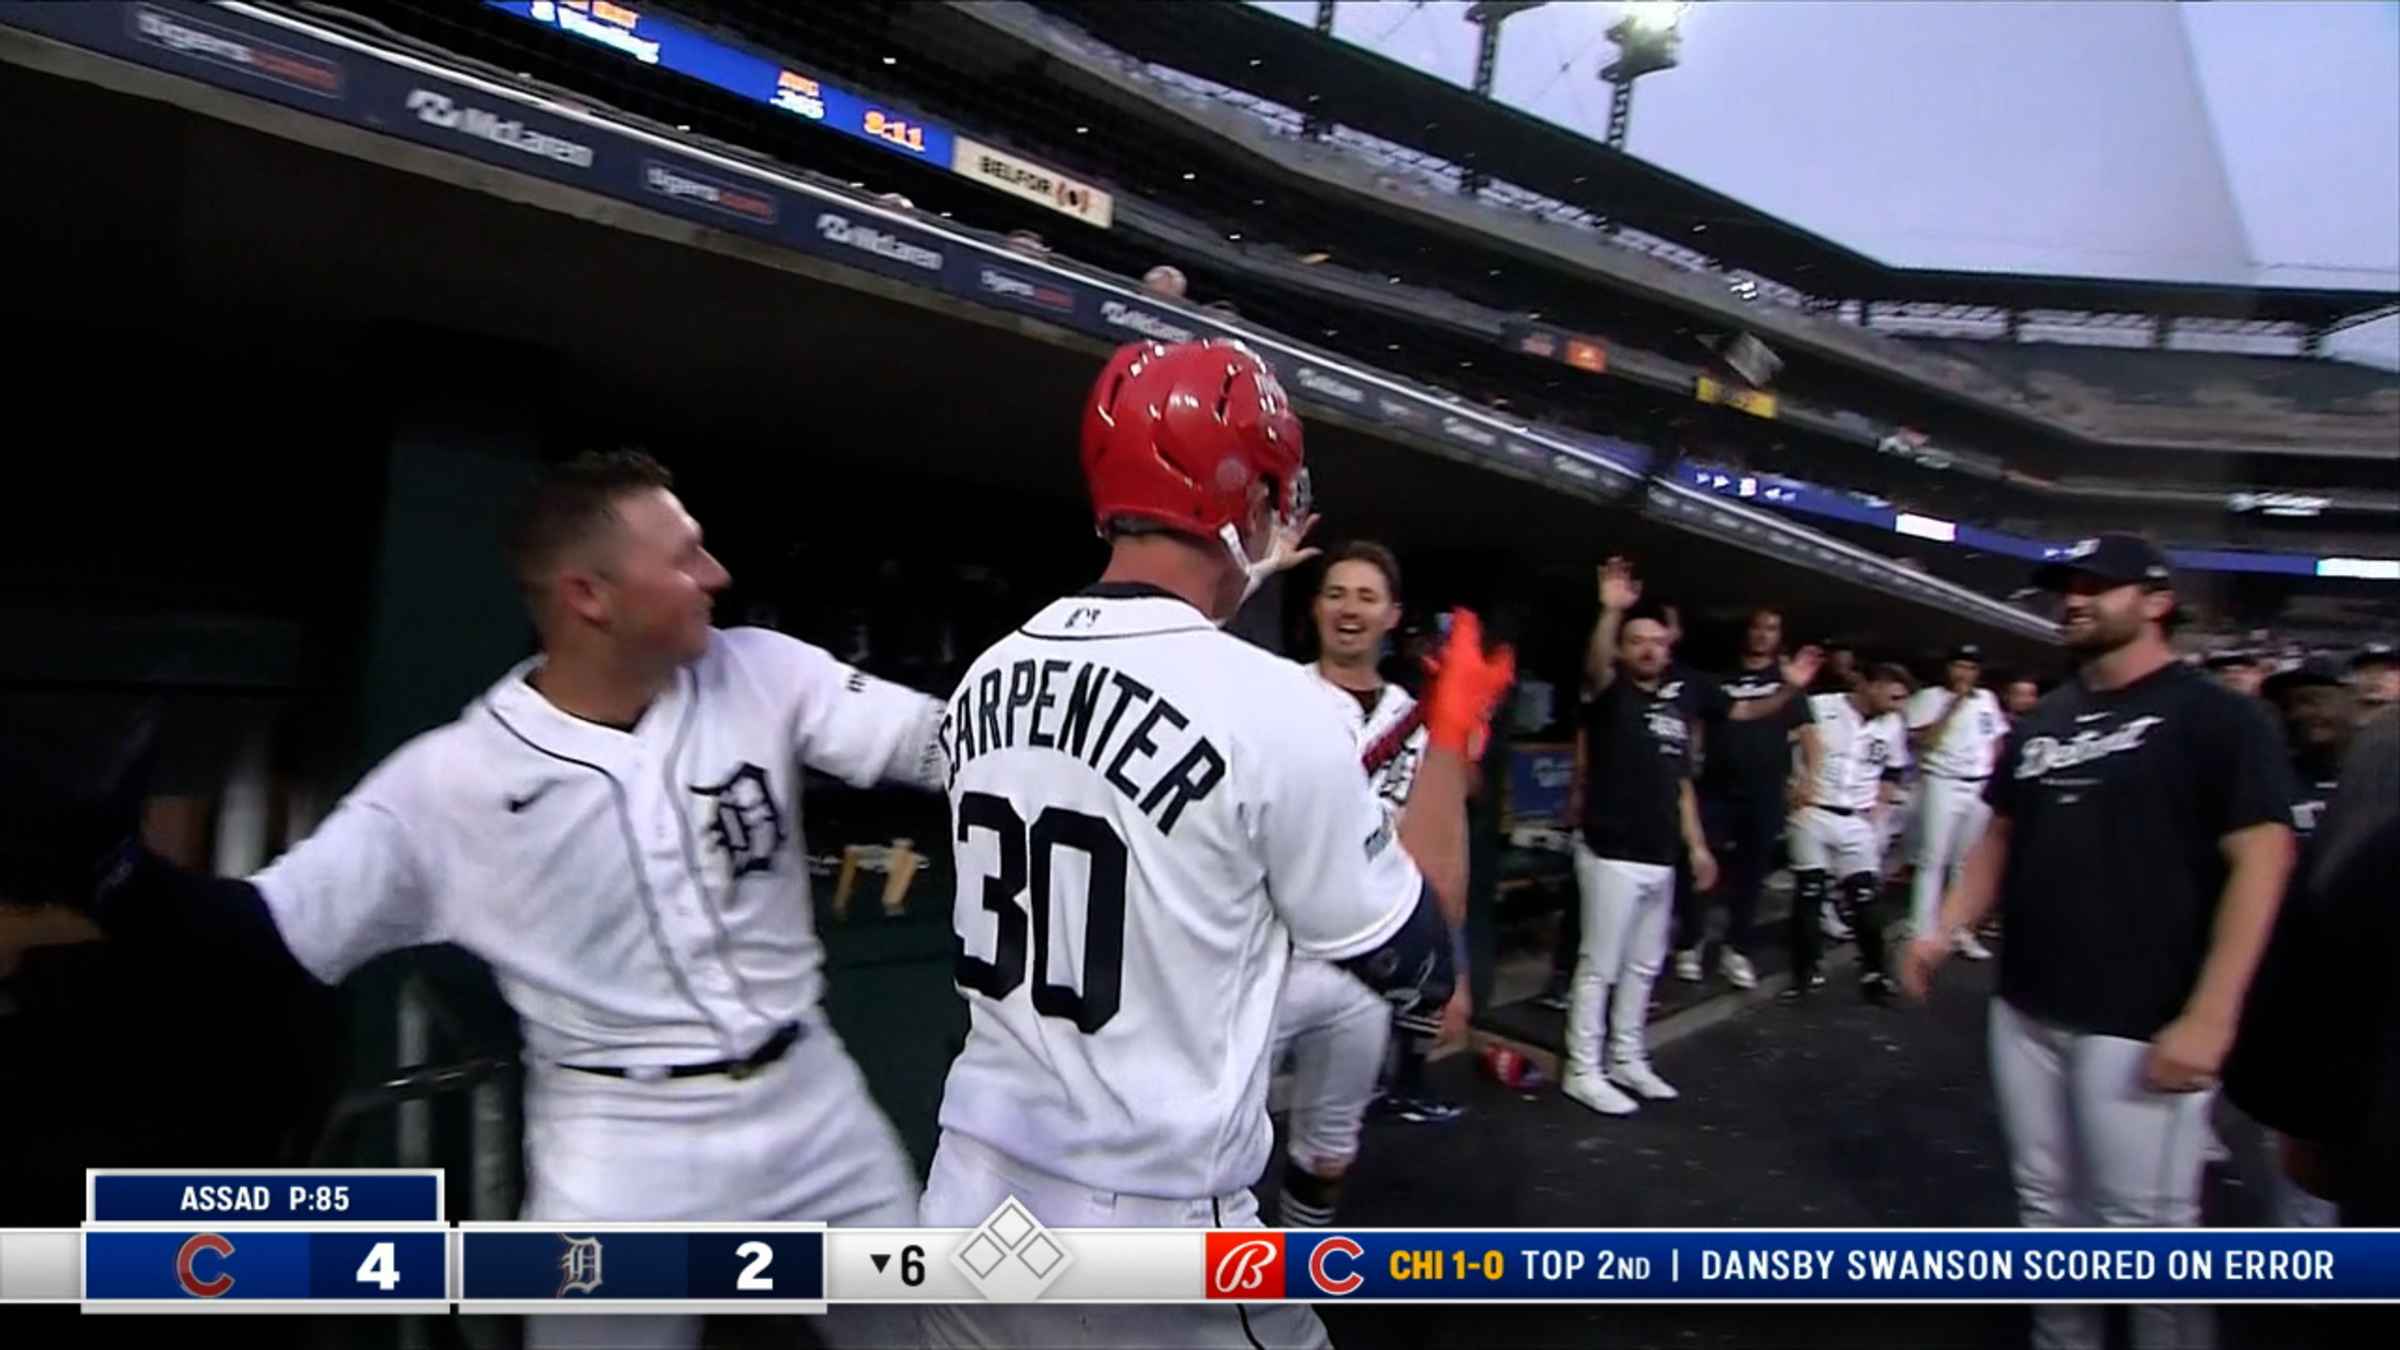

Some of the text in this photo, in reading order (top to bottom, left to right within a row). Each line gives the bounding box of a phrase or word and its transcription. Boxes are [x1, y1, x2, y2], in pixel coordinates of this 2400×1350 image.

[459, 107, 593, 168] McLaren
[979, 154, 1051, 194] BELFOR
[938, 659, 1227, 836] CARPENTER
[953, 790, 1128, 1036] 30
